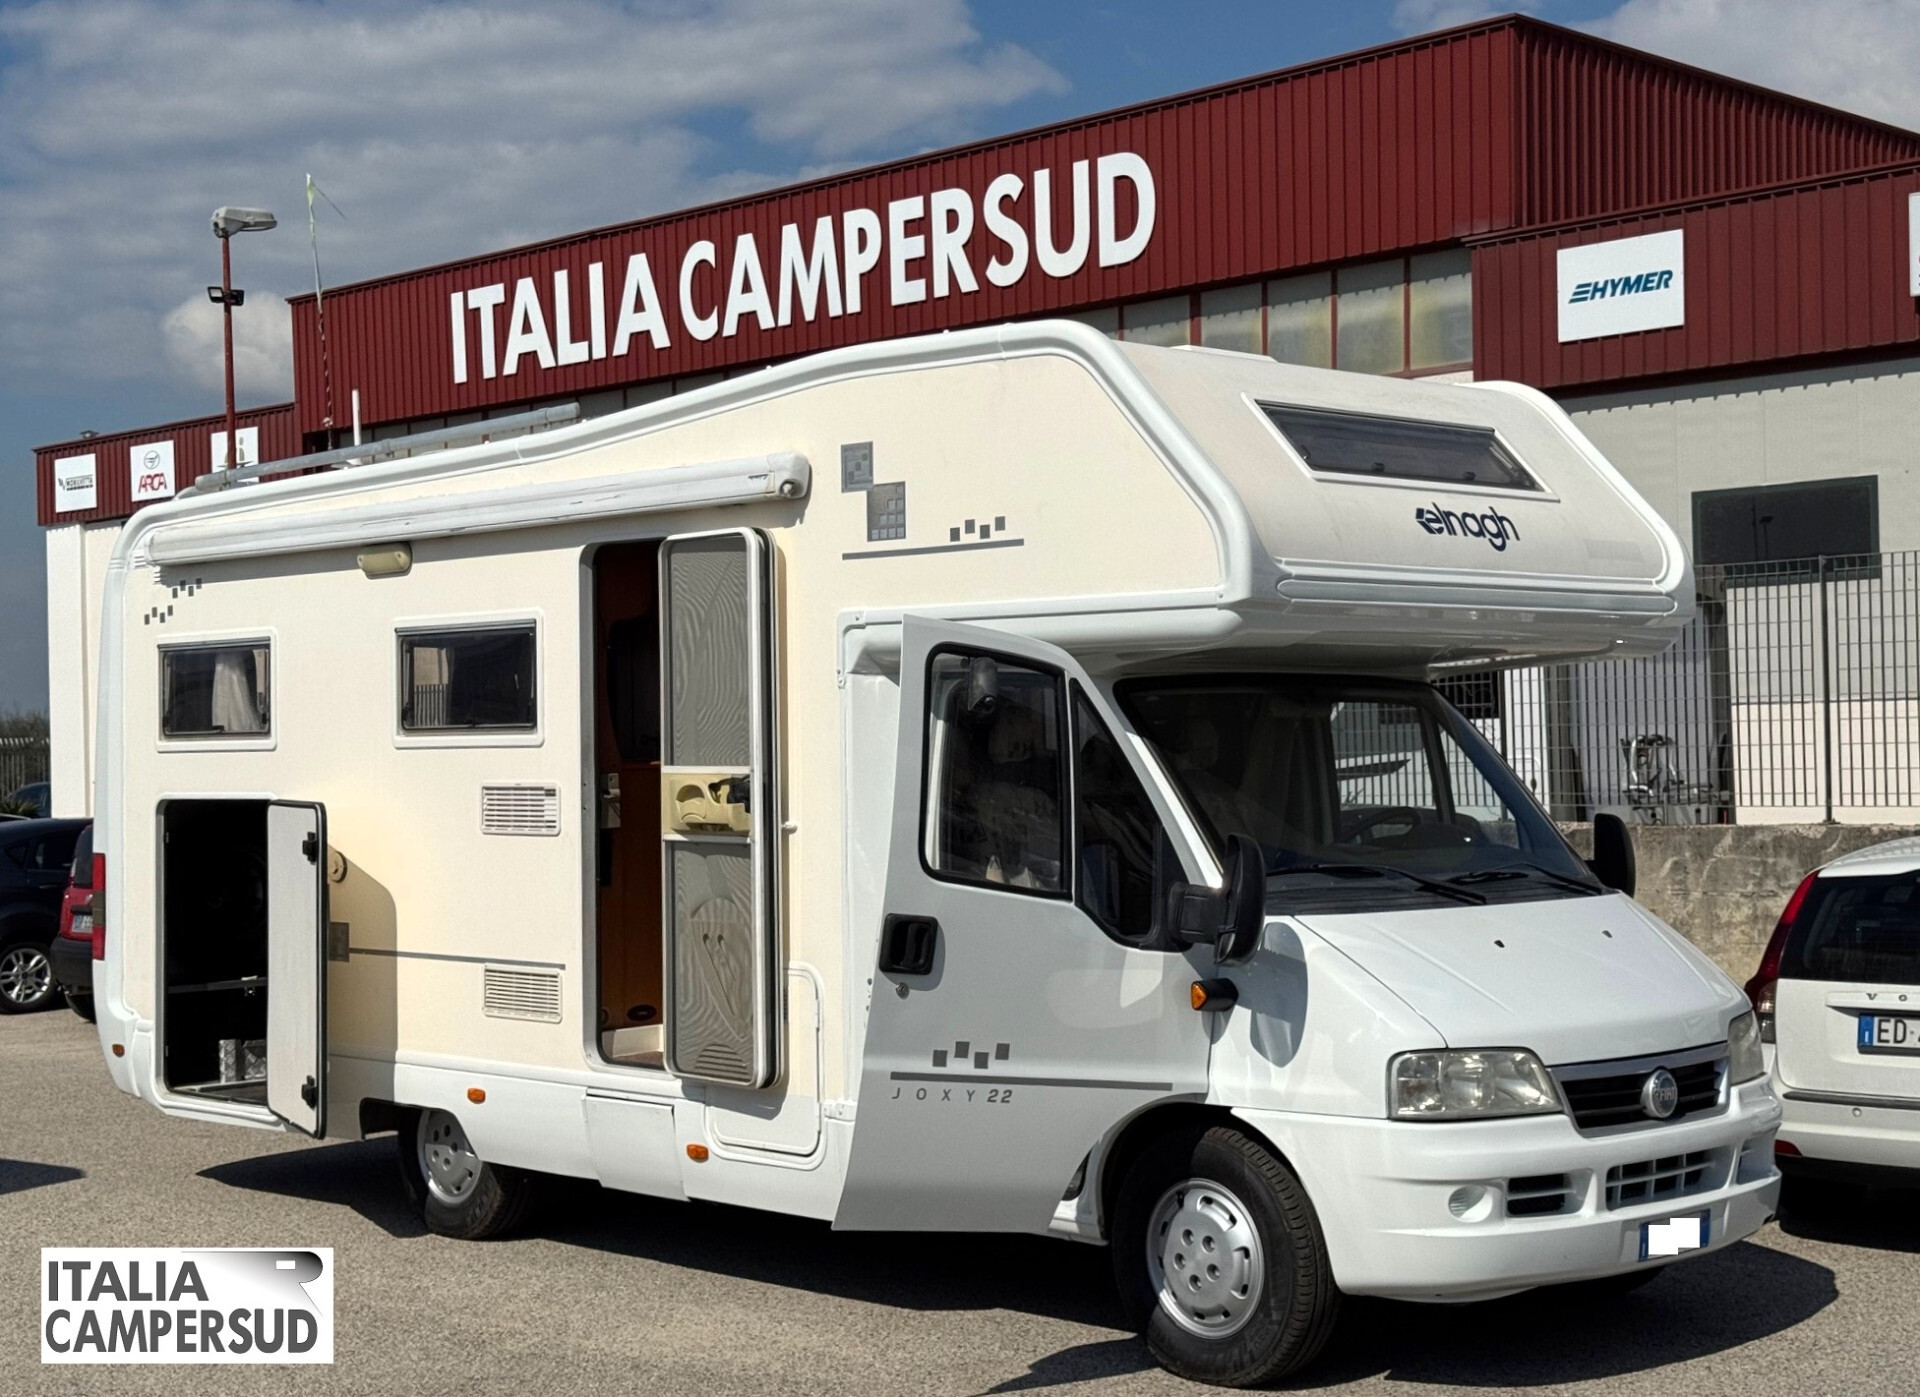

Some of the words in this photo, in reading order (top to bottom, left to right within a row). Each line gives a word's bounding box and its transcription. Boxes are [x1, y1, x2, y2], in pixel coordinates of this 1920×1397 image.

[451, 252, 671, 383] ITALIA
[680, 152, 1155, 341] CAMPERSUD
[1588, 269, 1673, 301] HYMER
[138, 473, 167, 493] ARCA
[1416, 501, 1520, 552] elnagh
